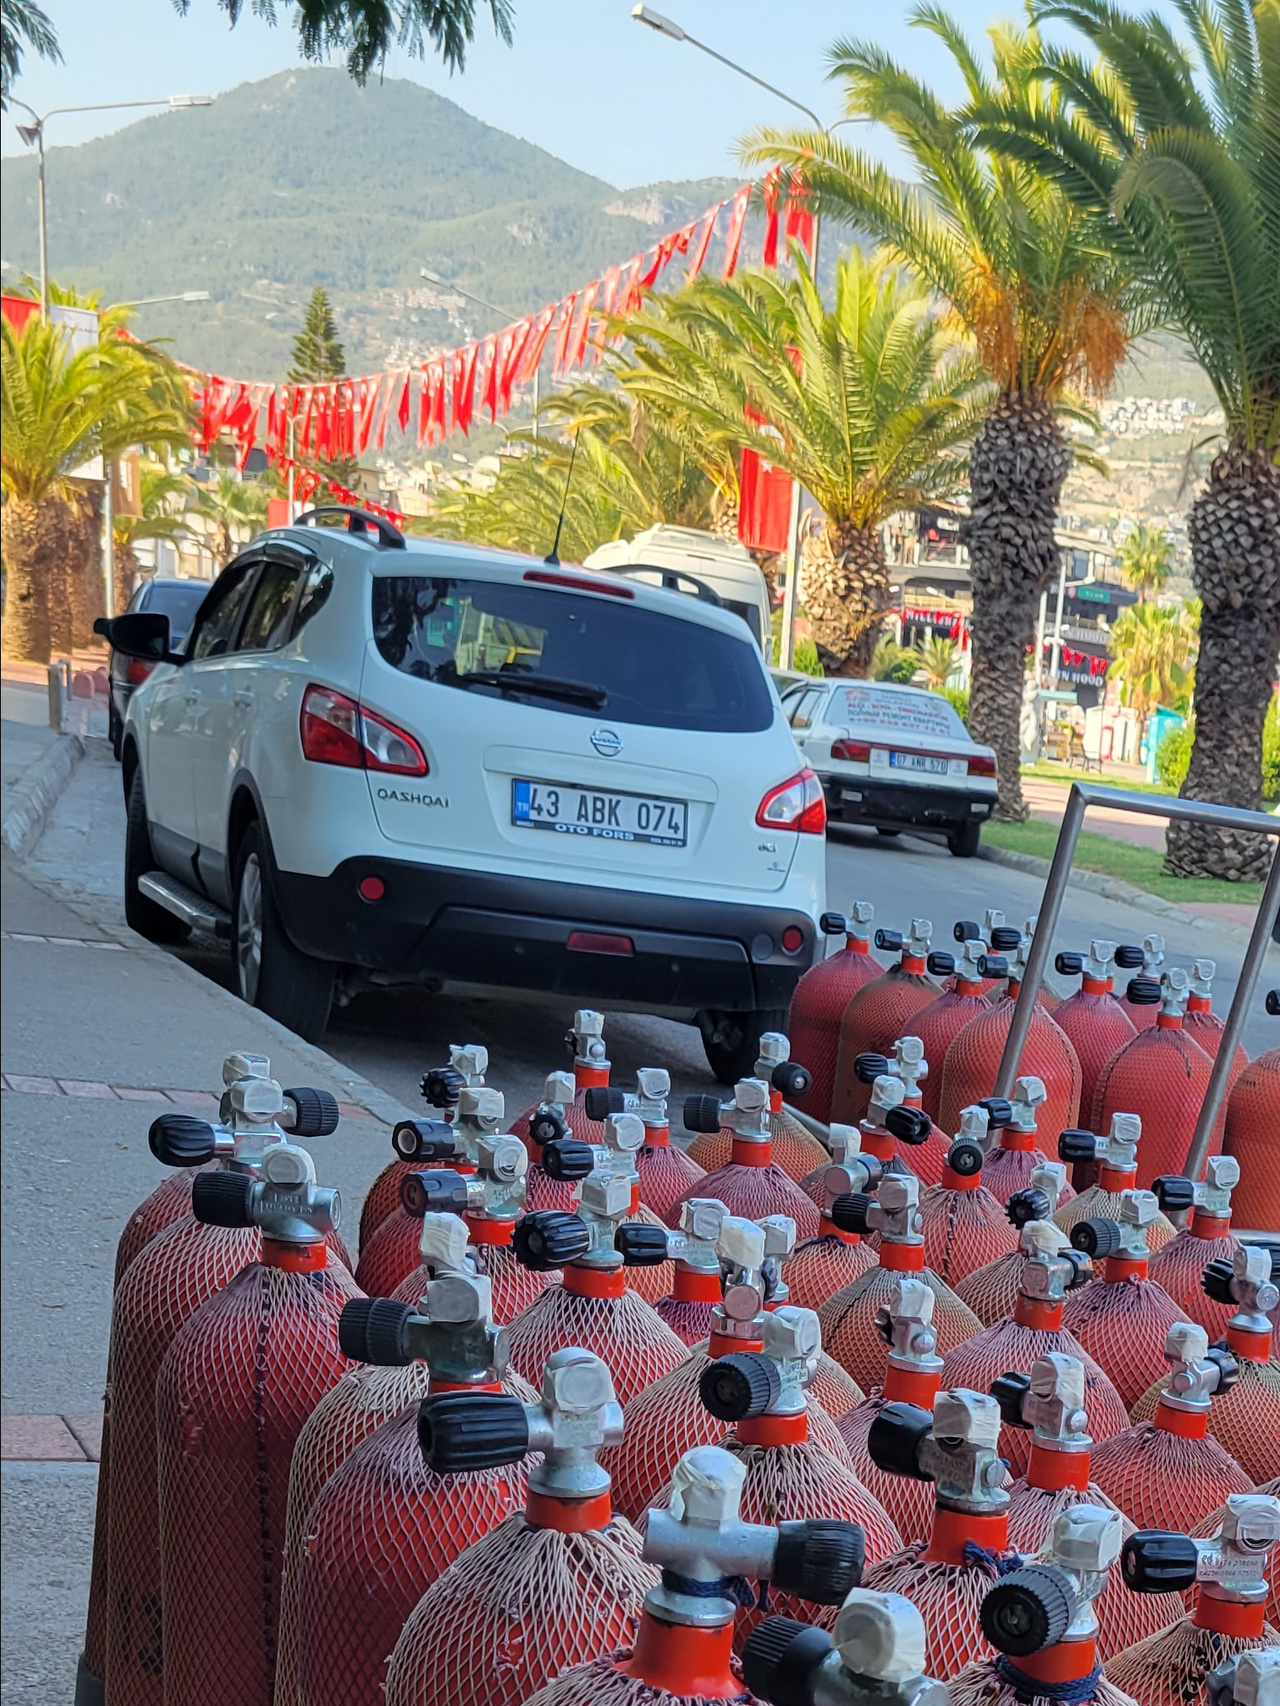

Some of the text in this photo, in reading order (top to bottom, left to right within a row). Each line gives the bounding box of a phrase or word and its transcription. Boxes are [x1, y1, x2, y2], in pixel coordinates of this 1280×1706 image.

[377, 788, 449, 808] QASHQAI
[531, 788, 560, 818] 43
[576, 794, 621, 827] ABK
[637, 802, 680, 835] 074
[554, 823, 635, 841] OTO FORS
